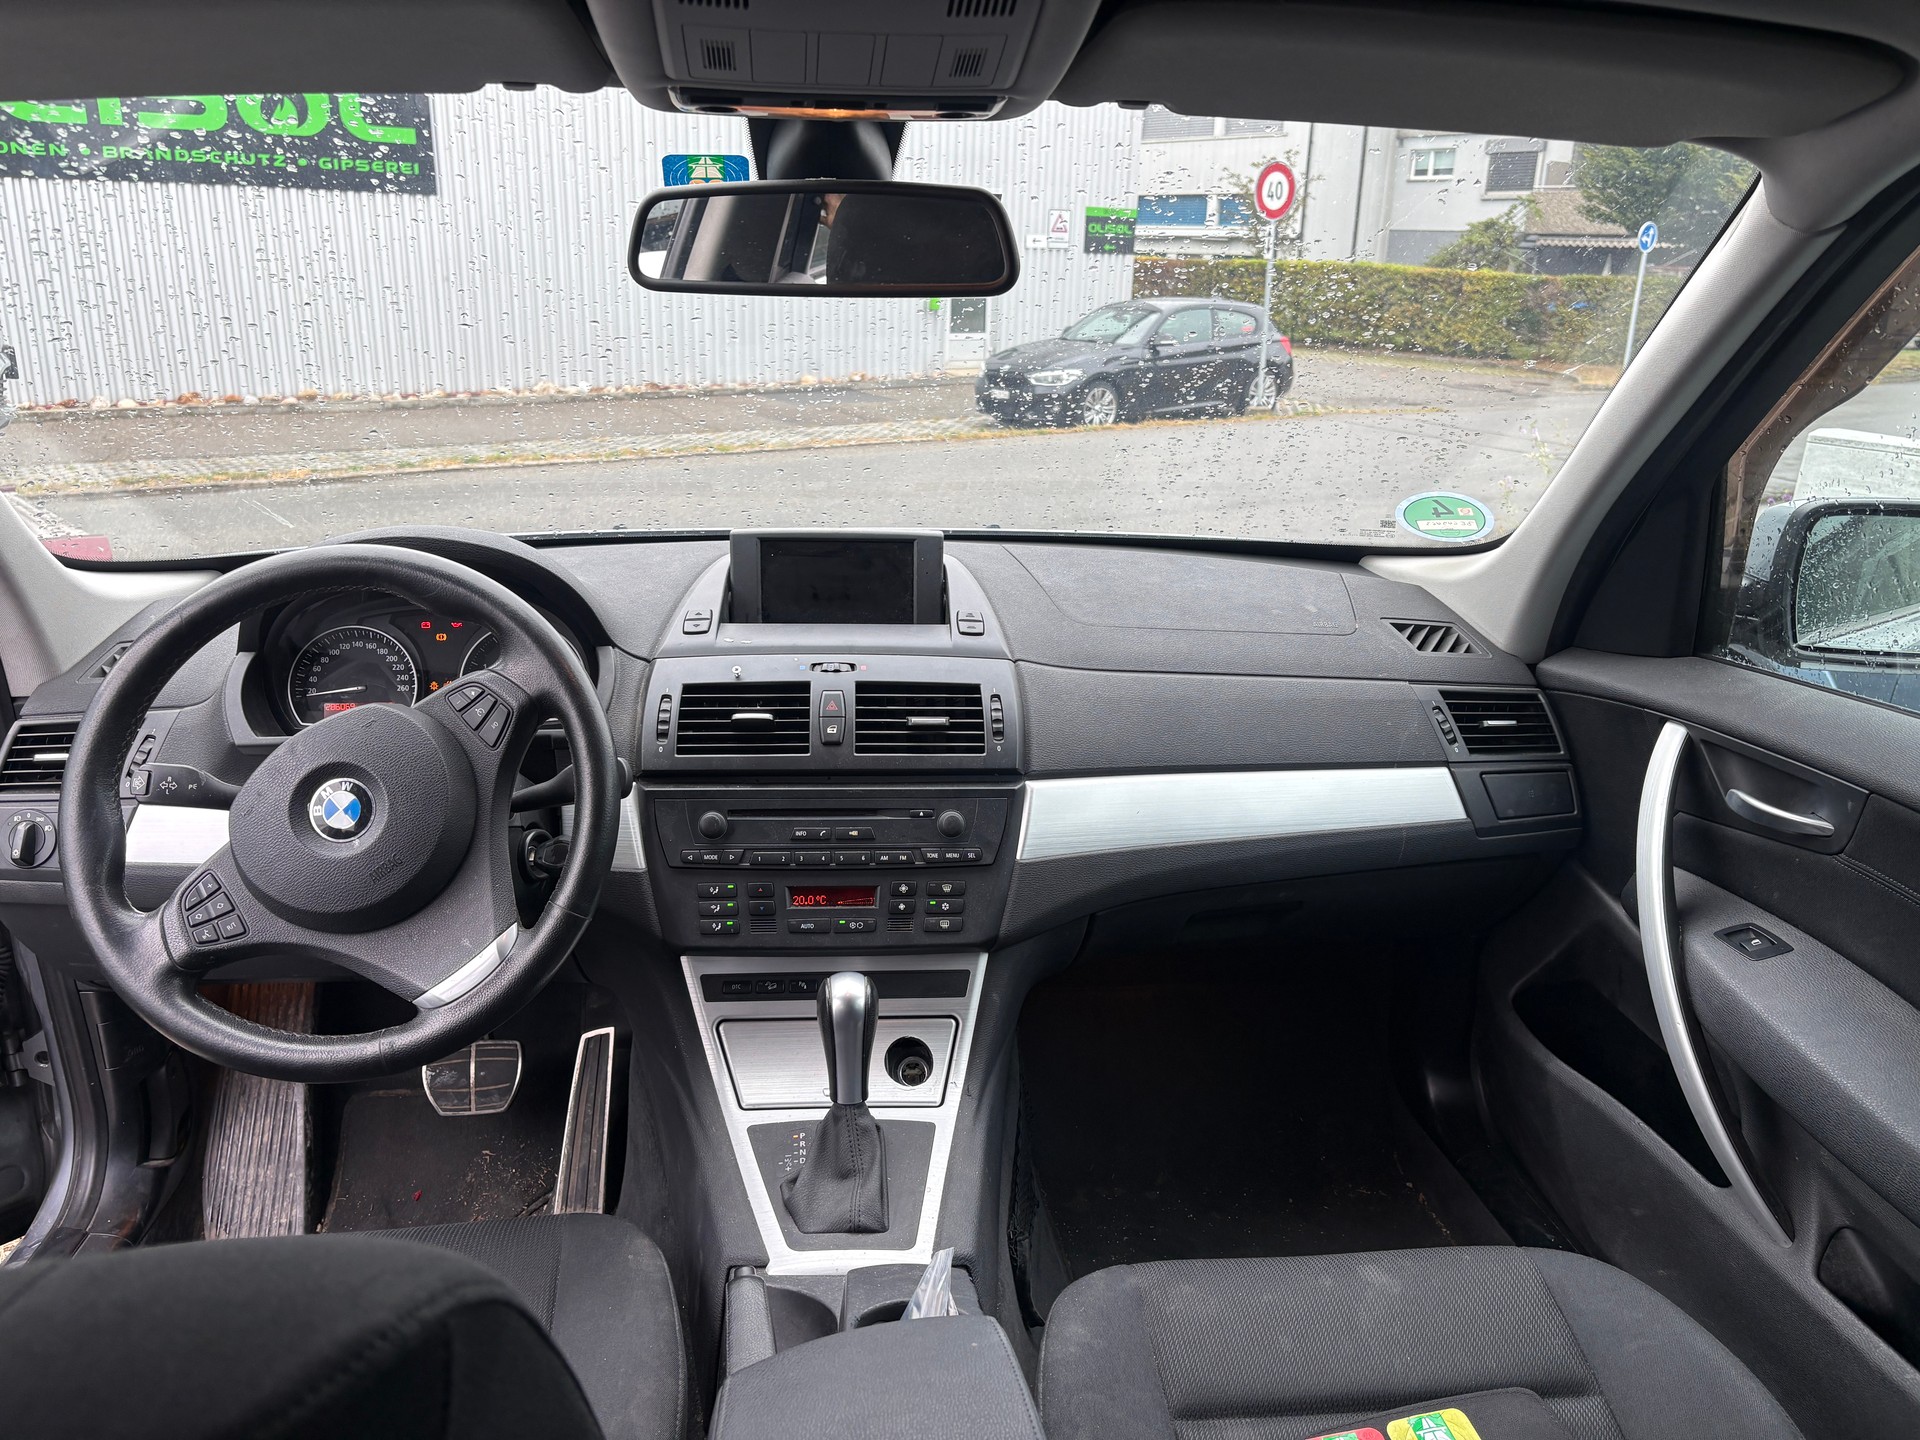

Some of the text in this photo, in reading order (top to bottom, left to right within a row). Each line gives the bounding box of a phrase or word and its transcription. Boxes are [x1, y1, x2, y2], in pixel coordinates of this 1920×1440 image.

[318, 157, 420, 175] GIPSEREI
[1266, 181, 1284, 201] 40
[397, 684, 410, 692] 260
[313, 781, 354, 817] BMW
[793, 895, 815, 905] 20.0
